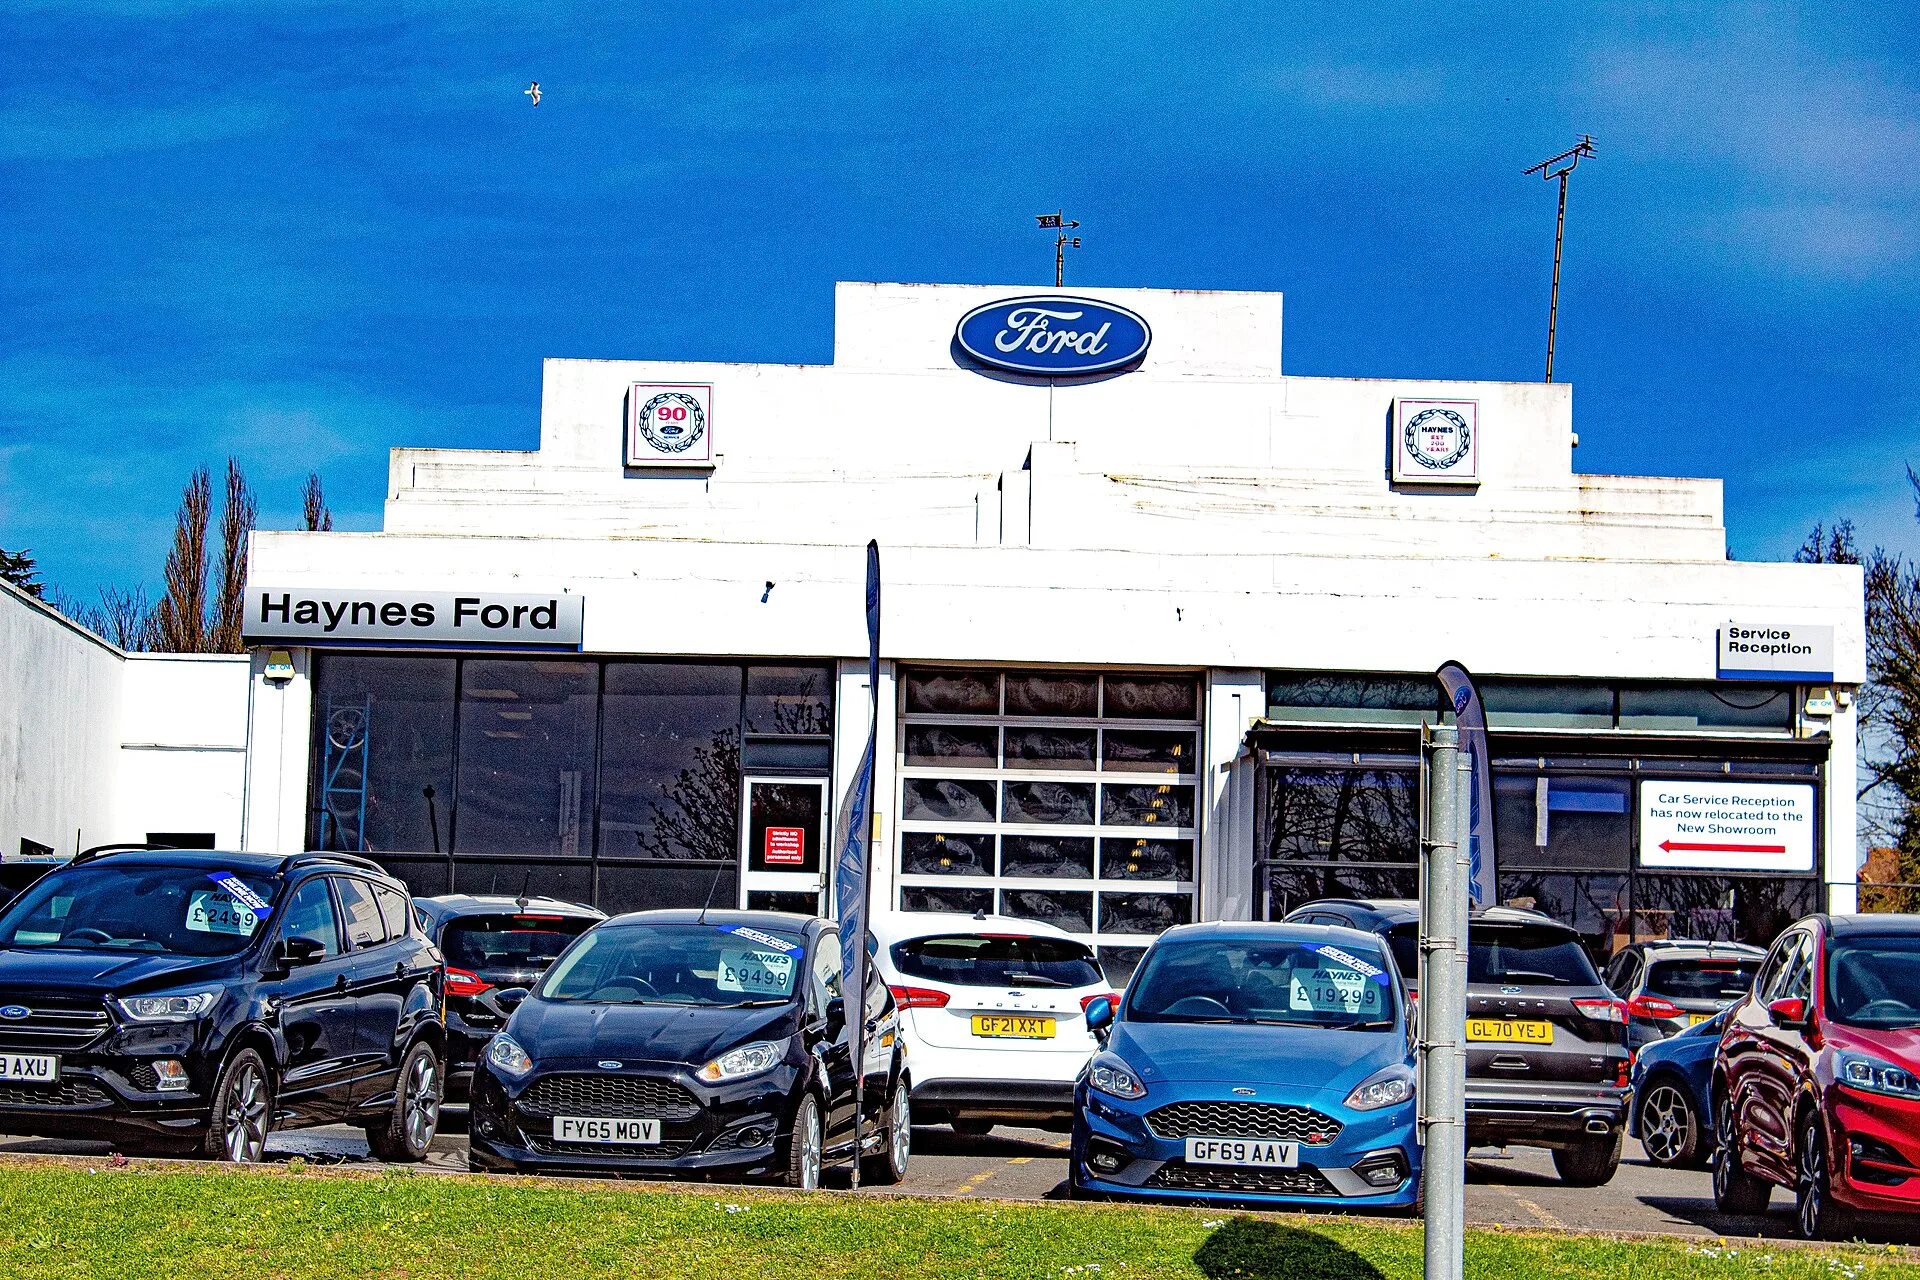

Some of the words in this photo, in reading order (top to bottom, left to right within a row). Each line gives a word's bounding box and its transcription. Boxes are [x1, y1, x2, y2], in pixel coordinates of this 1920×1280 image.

[995, 308, 1112, 355] Ford
[658, 407, 687, 421] 90
[1421, 426, 1454, 434] HAYNES
[260, 593, 436, 633] Haynes
[454, 597, 558, 630] Ford
[1729, 627, 1791, 640] Service
[1728, 641, 1812, 656] Reception
[1658, 793, 1680, 804] Car
[1683, 794, 1729, 805] Service
[1731, 796, 1795, 808] Reception
[1650, 808, 1673, 818] has
[1675, 810, 1701, 819] now
[1704, 809, 1764, 821] relocated
[1767, 812, 1780, 821] to
[1782, 811, 1803, 822] the
[1677, 823, 1705, 834] New
[1708, 823, 1777, 835] Showroom
[193, 907, 254, 926] £2499
[740, 952, 790, 965] HAYNES
[725, 967, 787, 986] £9499
[1311, 970, 1362, 981] HAYNES
[1297, 985, 1376, 1004] £19299
[981, 1017, 1014, 1032] GF21
[1019, 1018, 1046, 1033] XXT
[1472, 1022, 1512, 1037] GL70
[1516, 1024, 1546, 1038] YEJ
[12, 1058, 48, 1076] AXU
[562, 1120, 611, 1139] FY65
[616, 1122, 653, 1140] MOV
[1194, 1141, 1246, 1161] GF69
[1251, 1144, 1290, 1163] AAV
